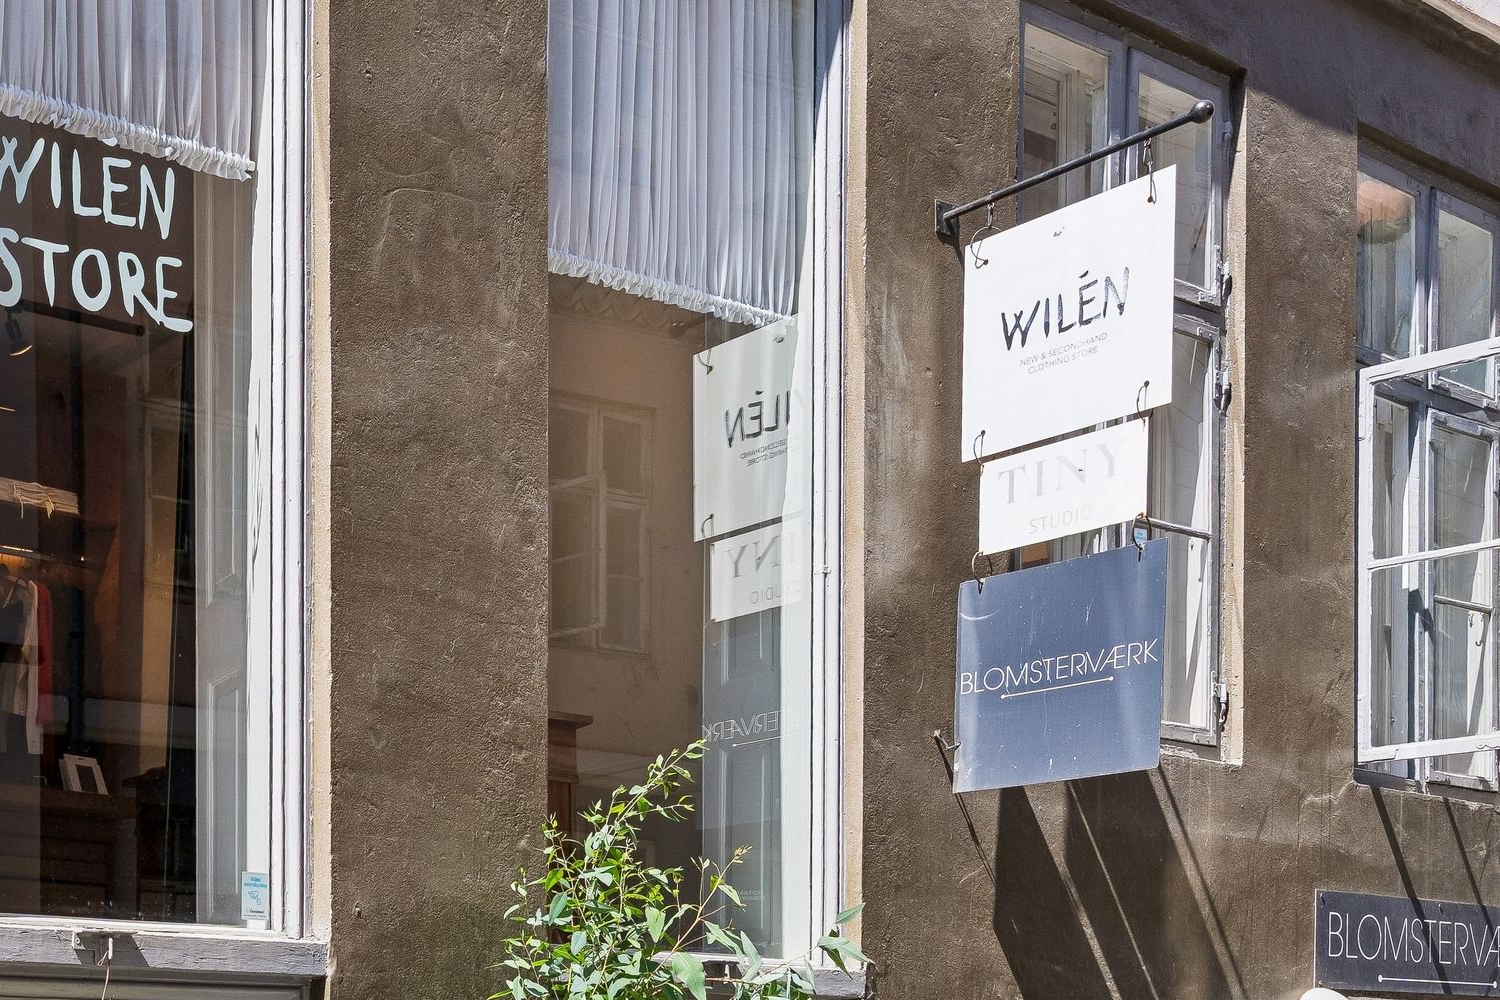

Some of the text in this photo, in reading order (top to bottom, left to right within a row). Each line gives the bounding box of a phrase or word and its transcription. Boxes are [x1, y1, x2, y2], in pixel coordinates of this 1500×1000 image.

[1001, 266, 1129, 351] WILÉN
[1019, 354, 1039, 367] NEW
[1048, 332, 1108, 358] SECONDHAND
[1027, 345, 1099, 374] CLOTHING STORE
[997, 434, 1130, 505] TINY
[1028, 504, 1093, 535] STUDIO
[960, 638, 1159, 695] BLOMSTERVÆRK
[1328, 911, 1500, 968] BLOMSTERVÆ
